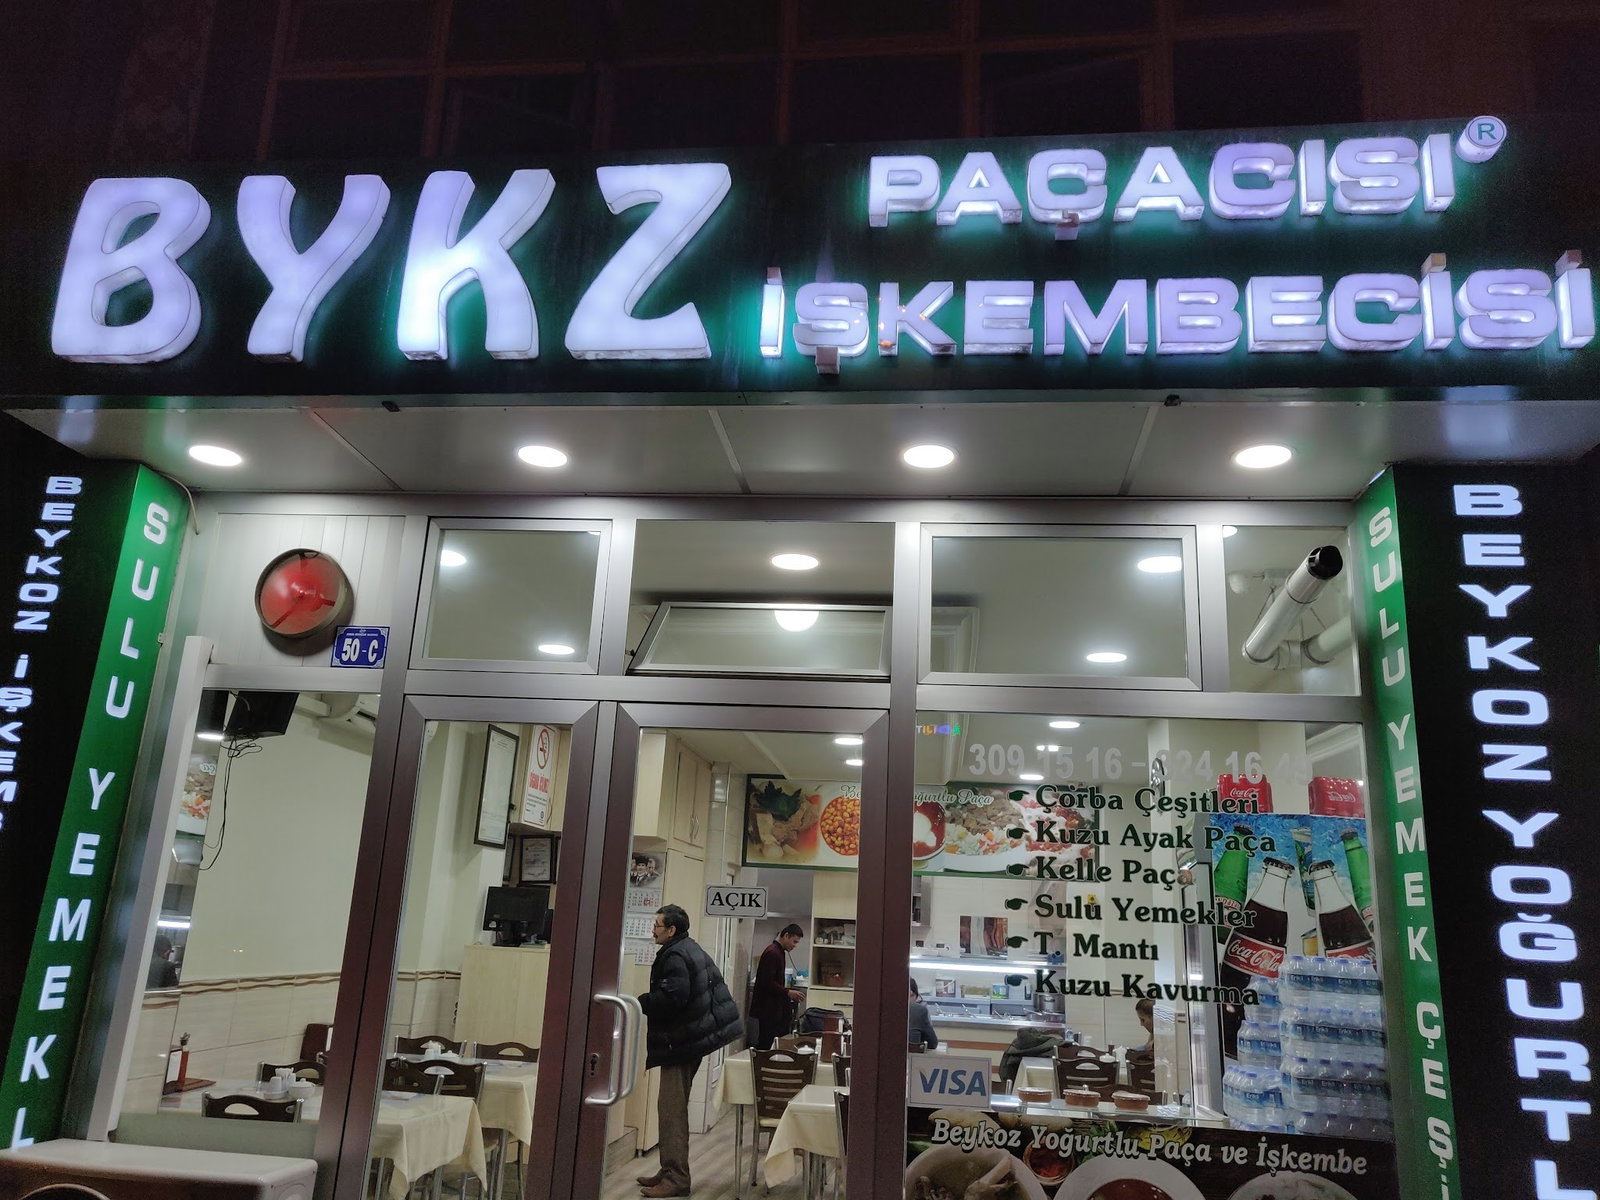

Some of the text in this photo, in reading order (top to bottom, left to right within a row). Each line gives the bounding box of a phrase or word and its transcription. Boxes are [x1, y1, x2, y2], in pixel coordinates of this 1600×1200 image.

[869, 133, 1454, 240] PAÇACISI
[51, 161, 732, 364] BYKZ
[760, 249, 1596, 375] İŞKEMBECİSİ
[14, 476, 82, 631] BEYKOZ
[106, 502, 169, 719] SULU
[1453, 484, 1552, 782] BEYKOZ
[1369, 506, 1406, 687] SULU
[1388, 713, 1432, 962] YEMEK
[969, 743, 1025, 776] 309
[1085, 745, 1122, 780] 16
[1225, 751, 1264, 784] 16
[1135, 788, 1259, 818] Çeşitleri
[1036, 821, 1276, 857] Kuzu Ayak Paça
[1036, 856, 1111, 882] Kelle
[710, 892, 762, 910] AÇIK
[1035, 894, 1103, 920] Sulu
[1111, 897, 1257, 928] Yemekler
[1073, 932, 1159, 961] Mantı
[1035, 970, 1111, 997] Kuzu
[1121, 974, 1260, 1006] Kavurma
[918, 1067, 987, 1097] VISA
[931, 1118, 1368, 1176] Beykoz Yoğurtlu Paça ve İşkembe
